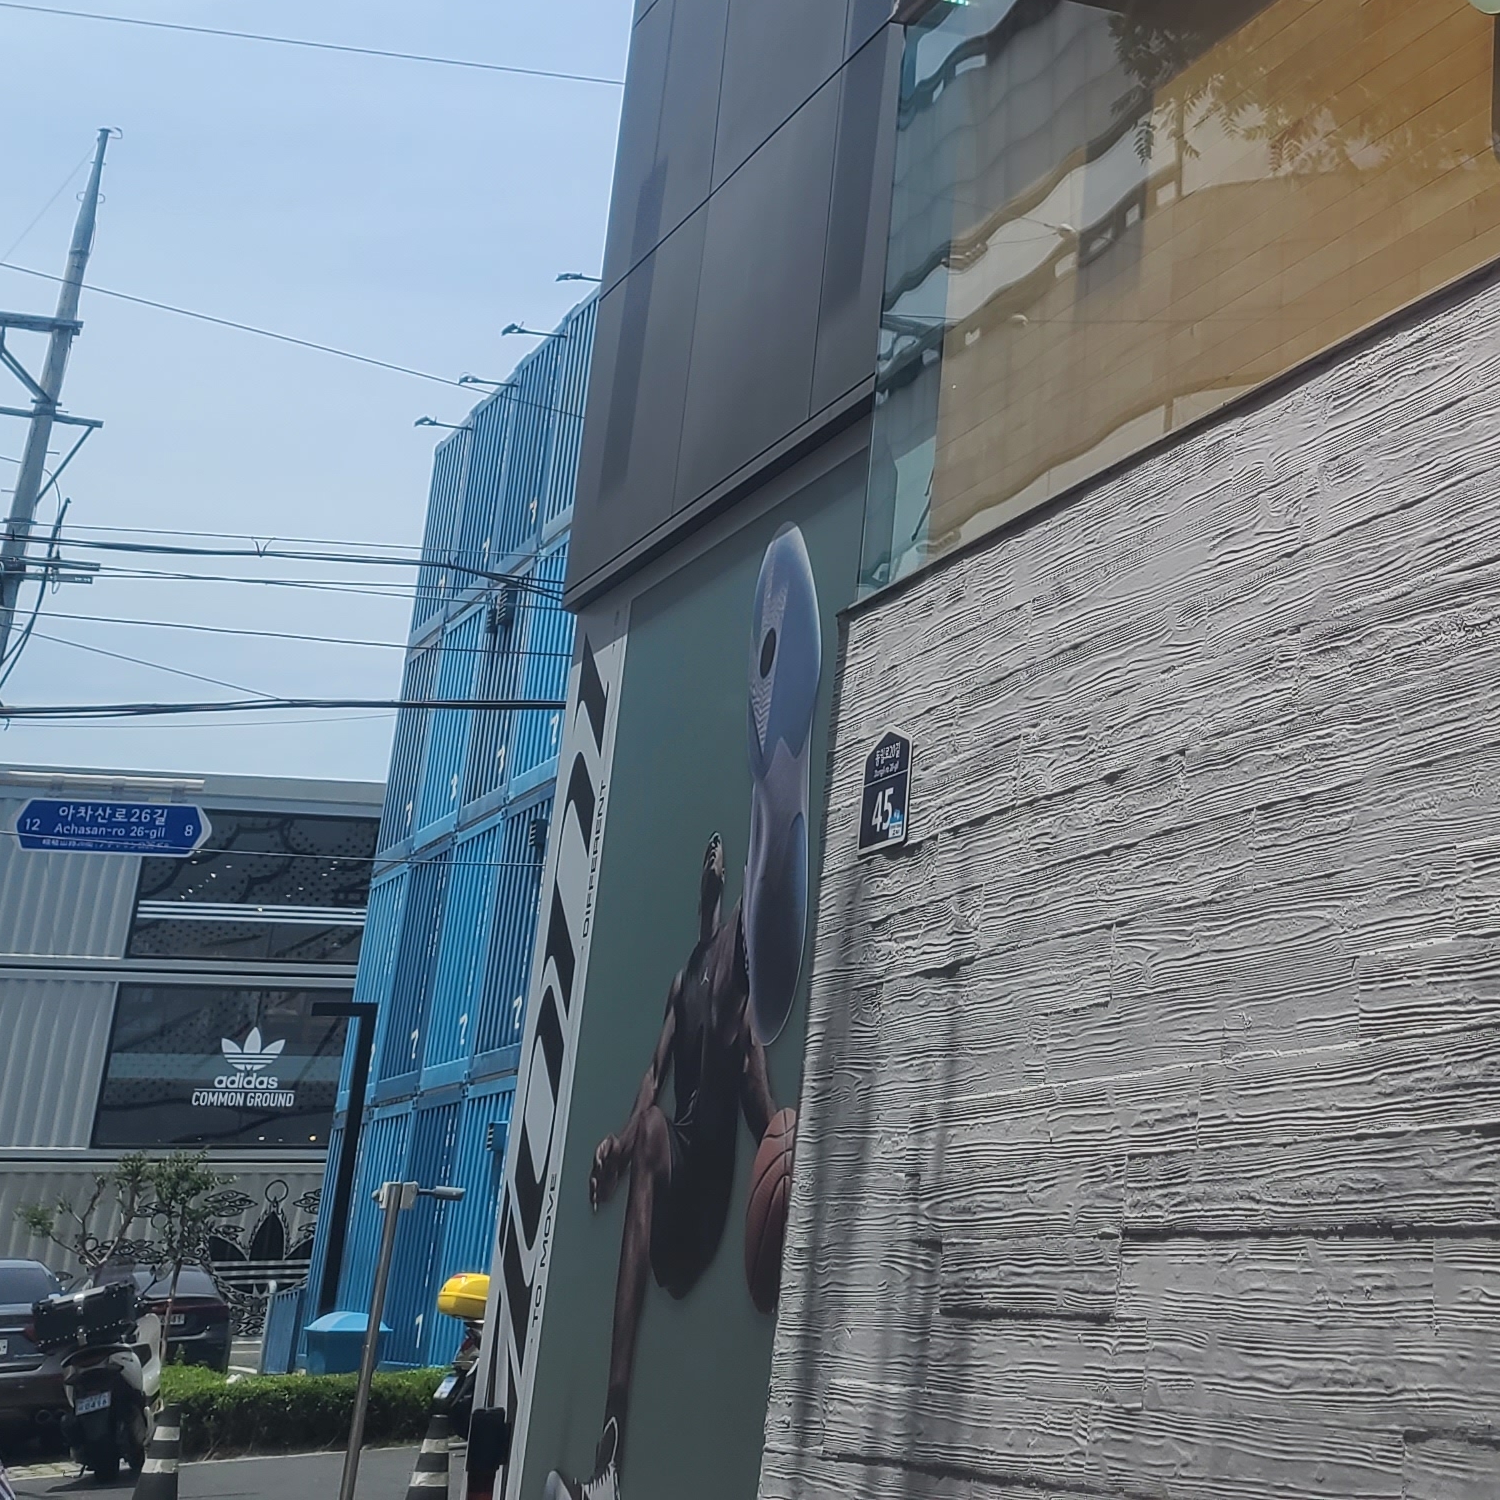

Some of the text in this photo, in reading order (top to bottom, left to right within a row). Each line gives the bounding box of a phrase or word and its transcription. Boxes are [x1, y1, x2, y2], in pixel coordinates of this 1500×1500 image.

[59, 805, 168, 825] 아차산로26길
[871, 787, 894, 832] 45
[25, 818, 41, 831] 12
[54, 823, 166, 839] Achasan-ro 26-gil
[184, 825, 194, 837] 8
[540, 1173, 558, 1268] MOVE
[582, 779, 607, 938] DIFFERENT
[214, 1072, 278, 1089] adidas
[191, 1091, 295, 1107] COMMON GROUND
